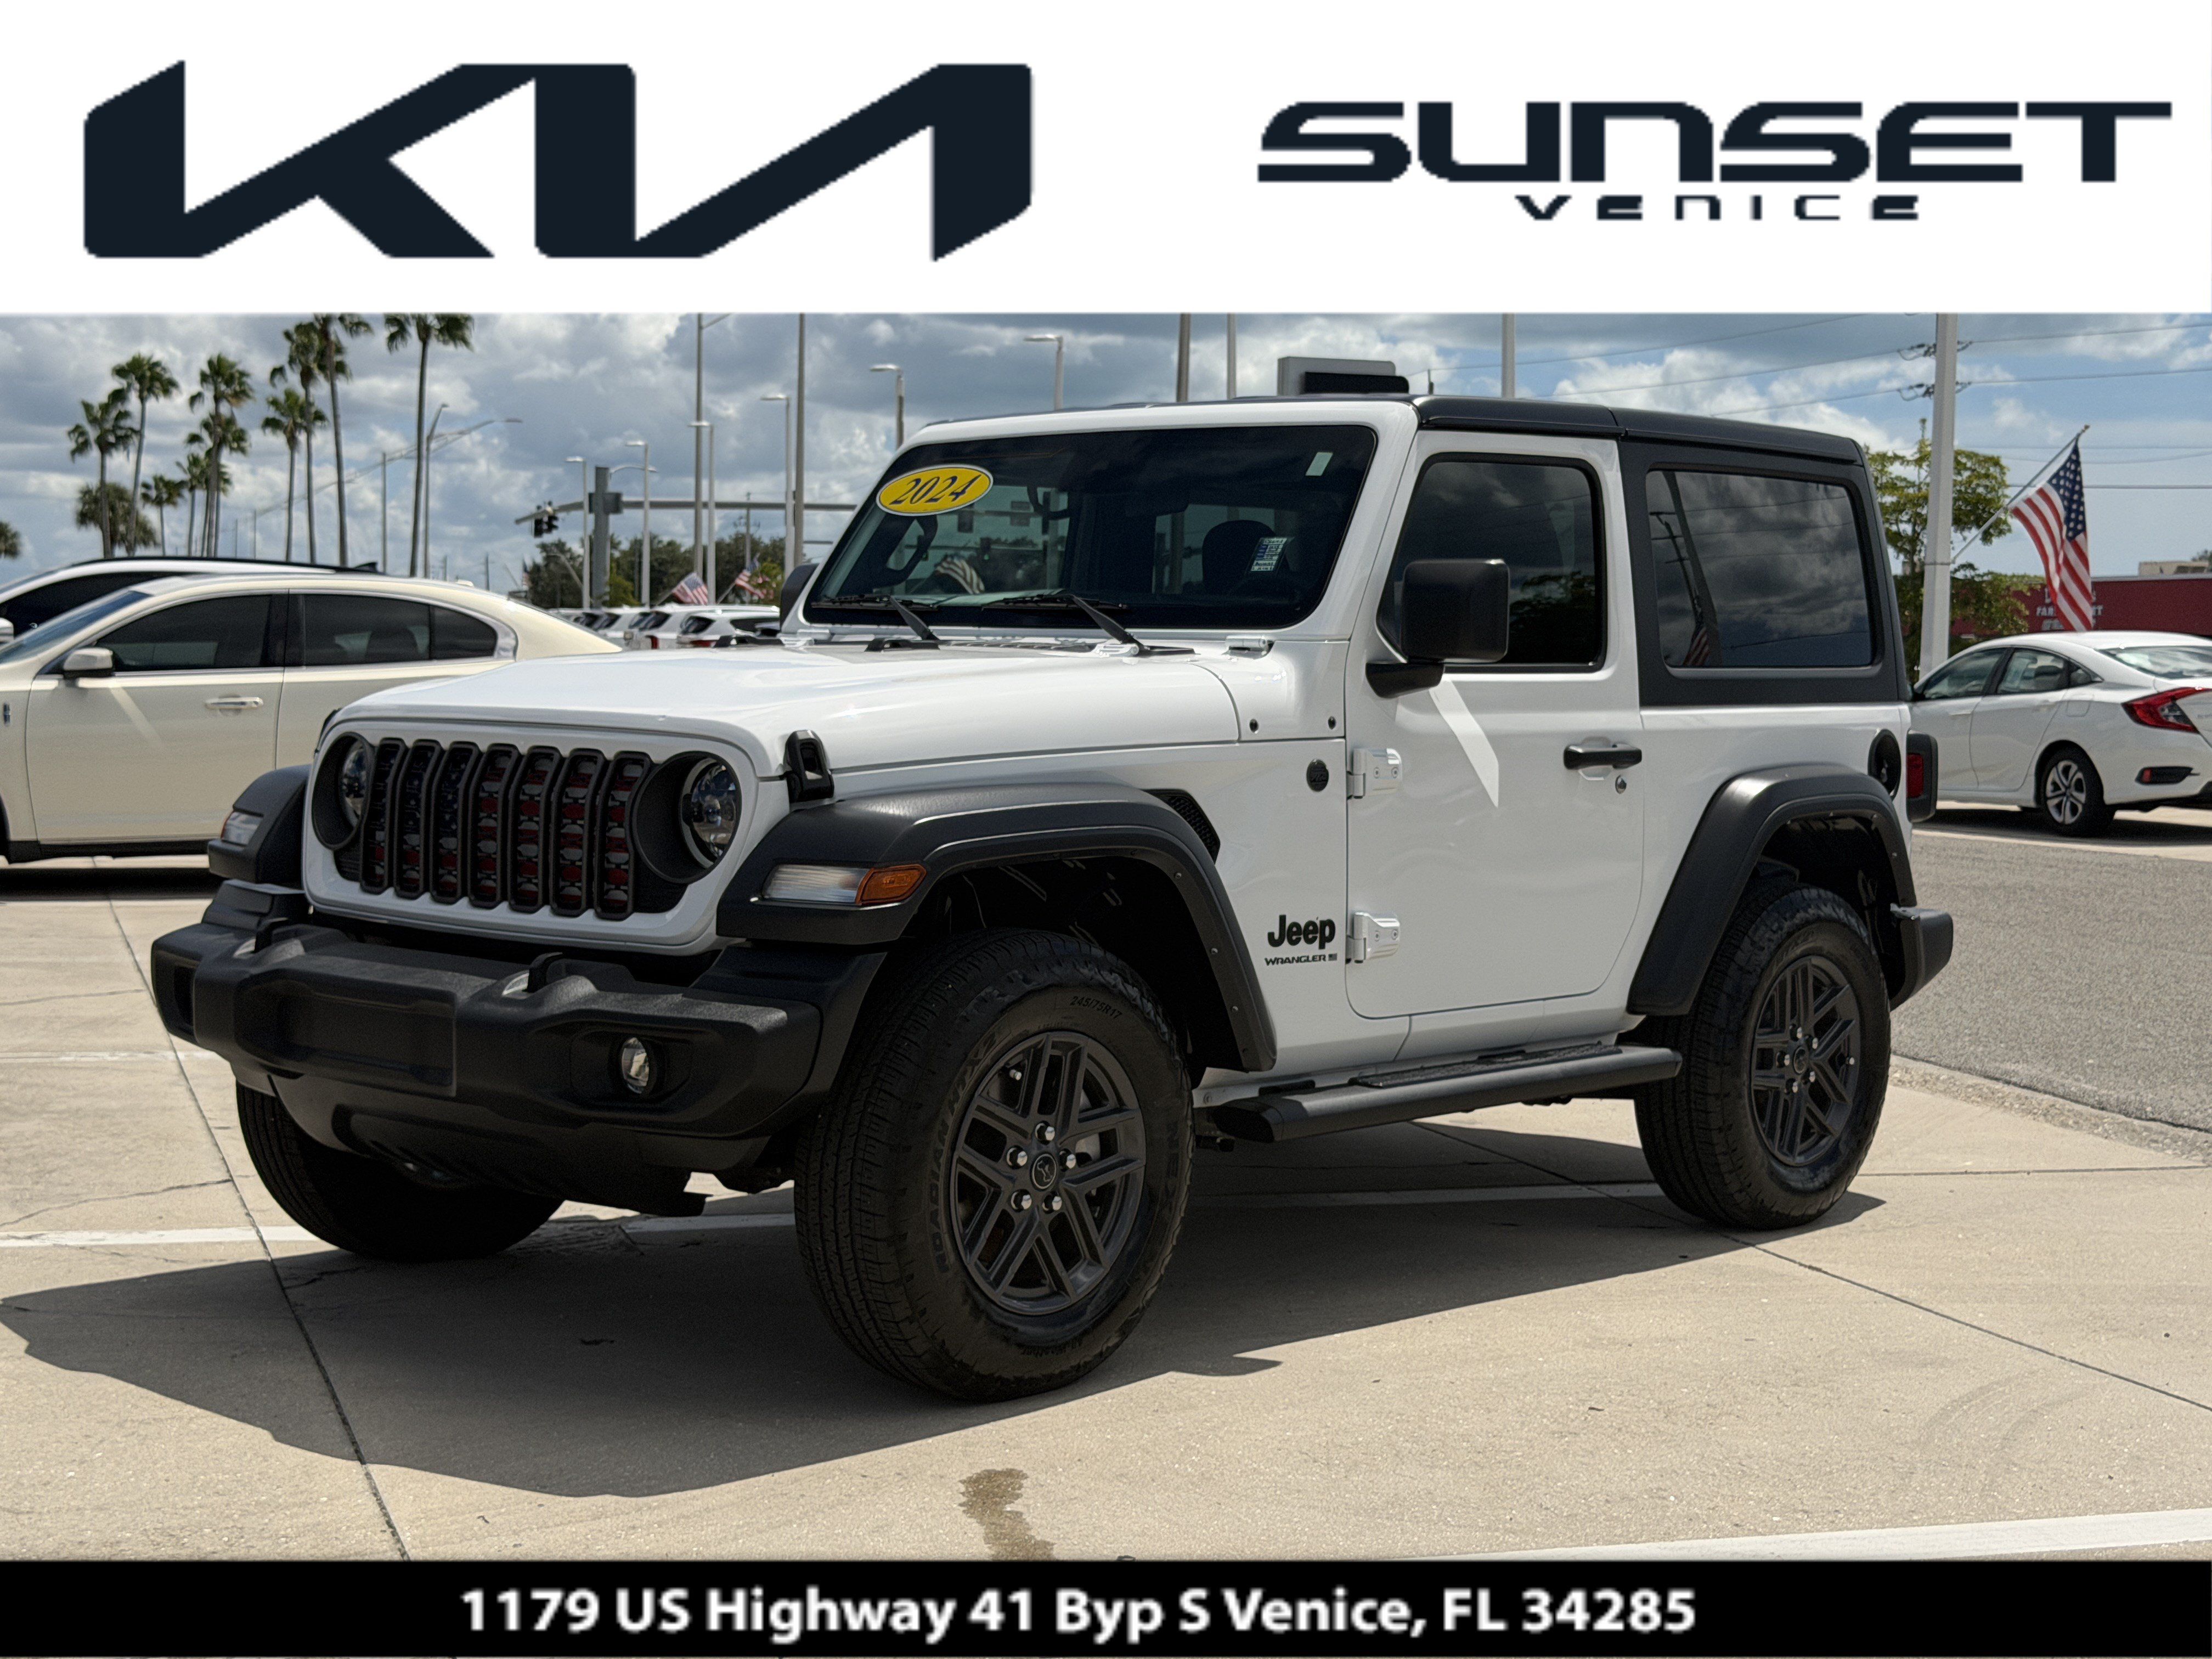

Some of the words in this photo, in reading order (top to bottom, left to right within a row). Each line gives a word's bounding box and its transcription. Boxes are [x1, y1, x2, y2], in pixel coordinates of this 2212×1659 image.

[889, 474, 982, 505] 2024
[1267, 914, 1336, 950] Jeep
[1264, 954, 1327, 966] WRANGLER
[1069, 996, 1123, 1019] 245/75R17
